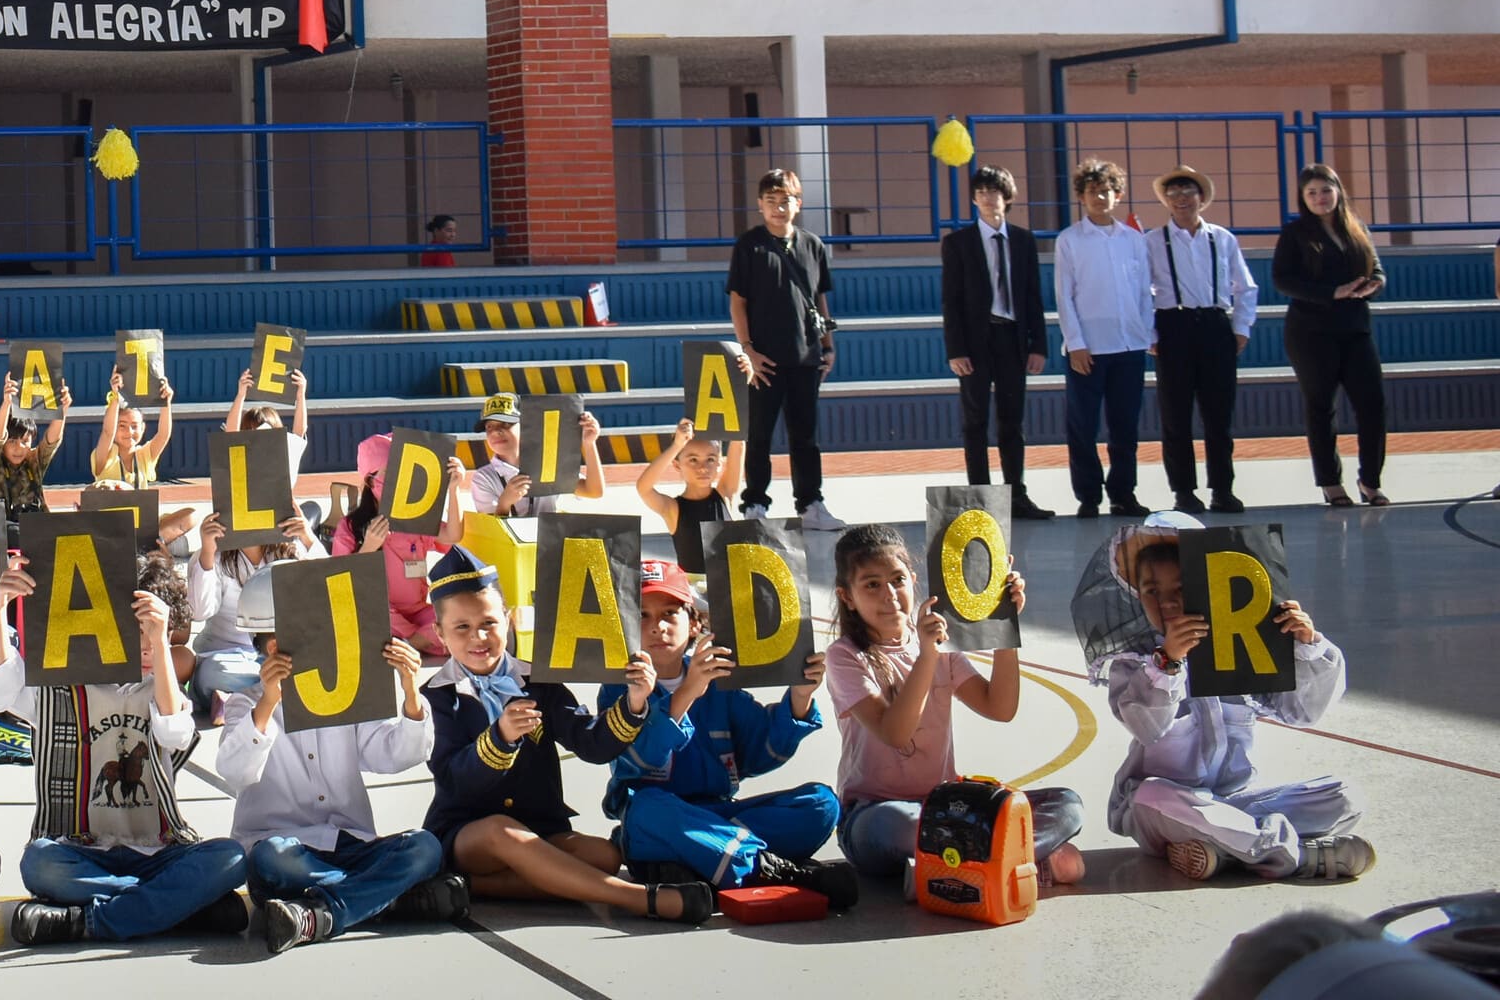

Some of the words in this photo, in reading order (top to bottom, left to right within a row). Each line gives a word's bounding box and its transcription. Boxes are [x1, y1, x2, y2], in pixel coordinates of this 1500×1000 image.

[227, 6, 287, 40] M.P
[20, 349, 57, 410] A
[124, 339, 157, 397] T
[256, 333, 293, 395] E
[693, 354, 741, 433] A
[486, 400, 512, 411] TAXI
[389, 442, 444, 521] D
[539, 409, 562, 484] I
[228, 444, 277, 532] L
[42, 533, 128, 671] A
[548, 537, 630, 671] A
[727, 543, 802, 667] D
[941, 509, 1008, 622] O
[292, 571, 363, 718] J
[1206, 551, 1278, 674] R
